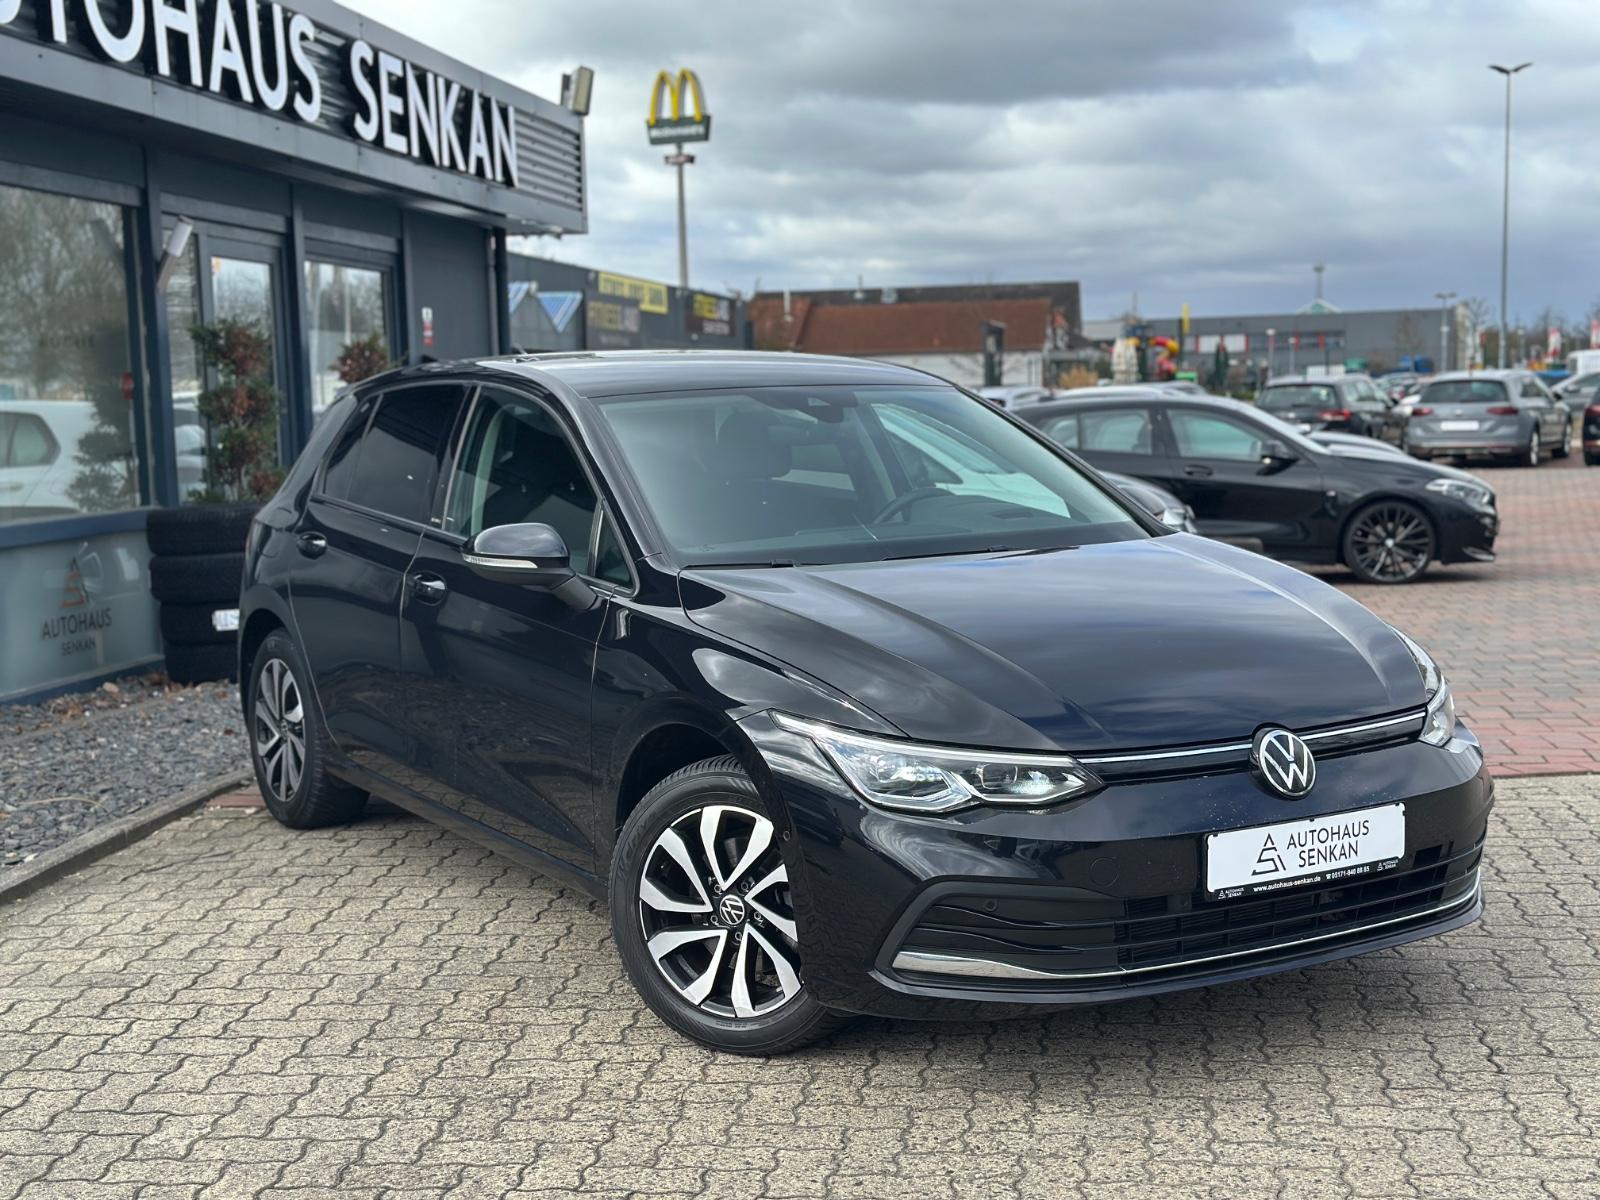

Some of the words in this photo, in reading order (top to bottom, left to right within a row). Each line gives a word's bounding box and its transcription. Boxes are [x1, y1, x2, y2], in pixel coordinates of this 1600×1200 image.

[0, 0, 321, 122] OHAUS
[350, 39, 519, 188] SENKAN
[41, 607, 112, 640] AUTOHAUS
[61, 636, 96, 656] SENKAN
[1286, 819, 1370, 850] AUTOHAUS
[1298, 840, 1359, 868] SENKAN
[1253, 875, 1321, 892] www.autohaus-senkan.de
